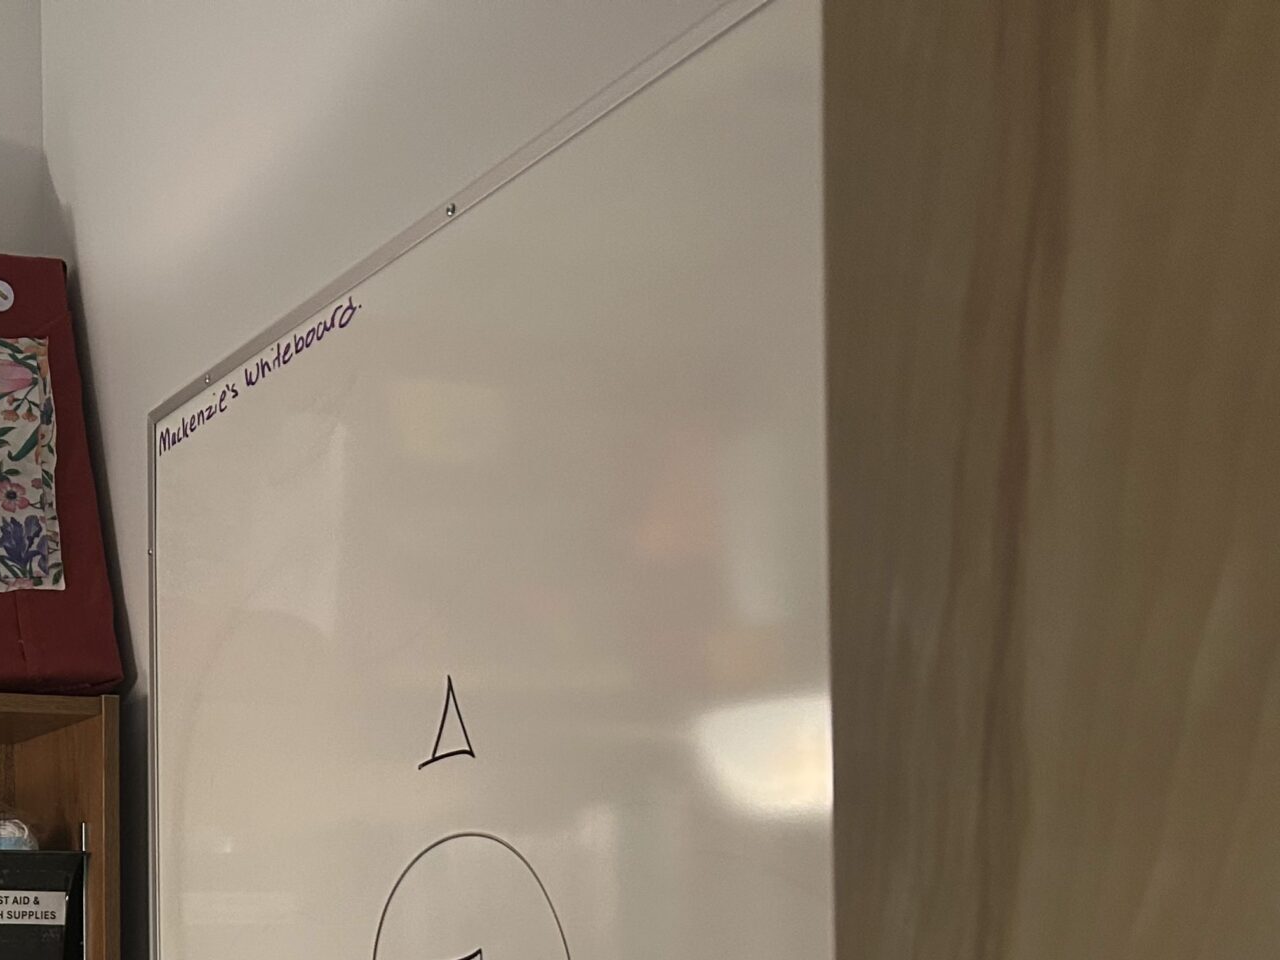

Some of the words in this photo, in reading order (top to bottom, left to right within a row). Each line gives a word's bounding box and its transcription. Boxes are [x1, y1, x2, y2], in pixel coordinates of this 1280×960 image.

[159, 383, 239, 456] Mackenzie's
[12, 896, 30, 905] AID
[33, 896, 40, 905] &
[6, 910, 57, 920] SUPPLIES
